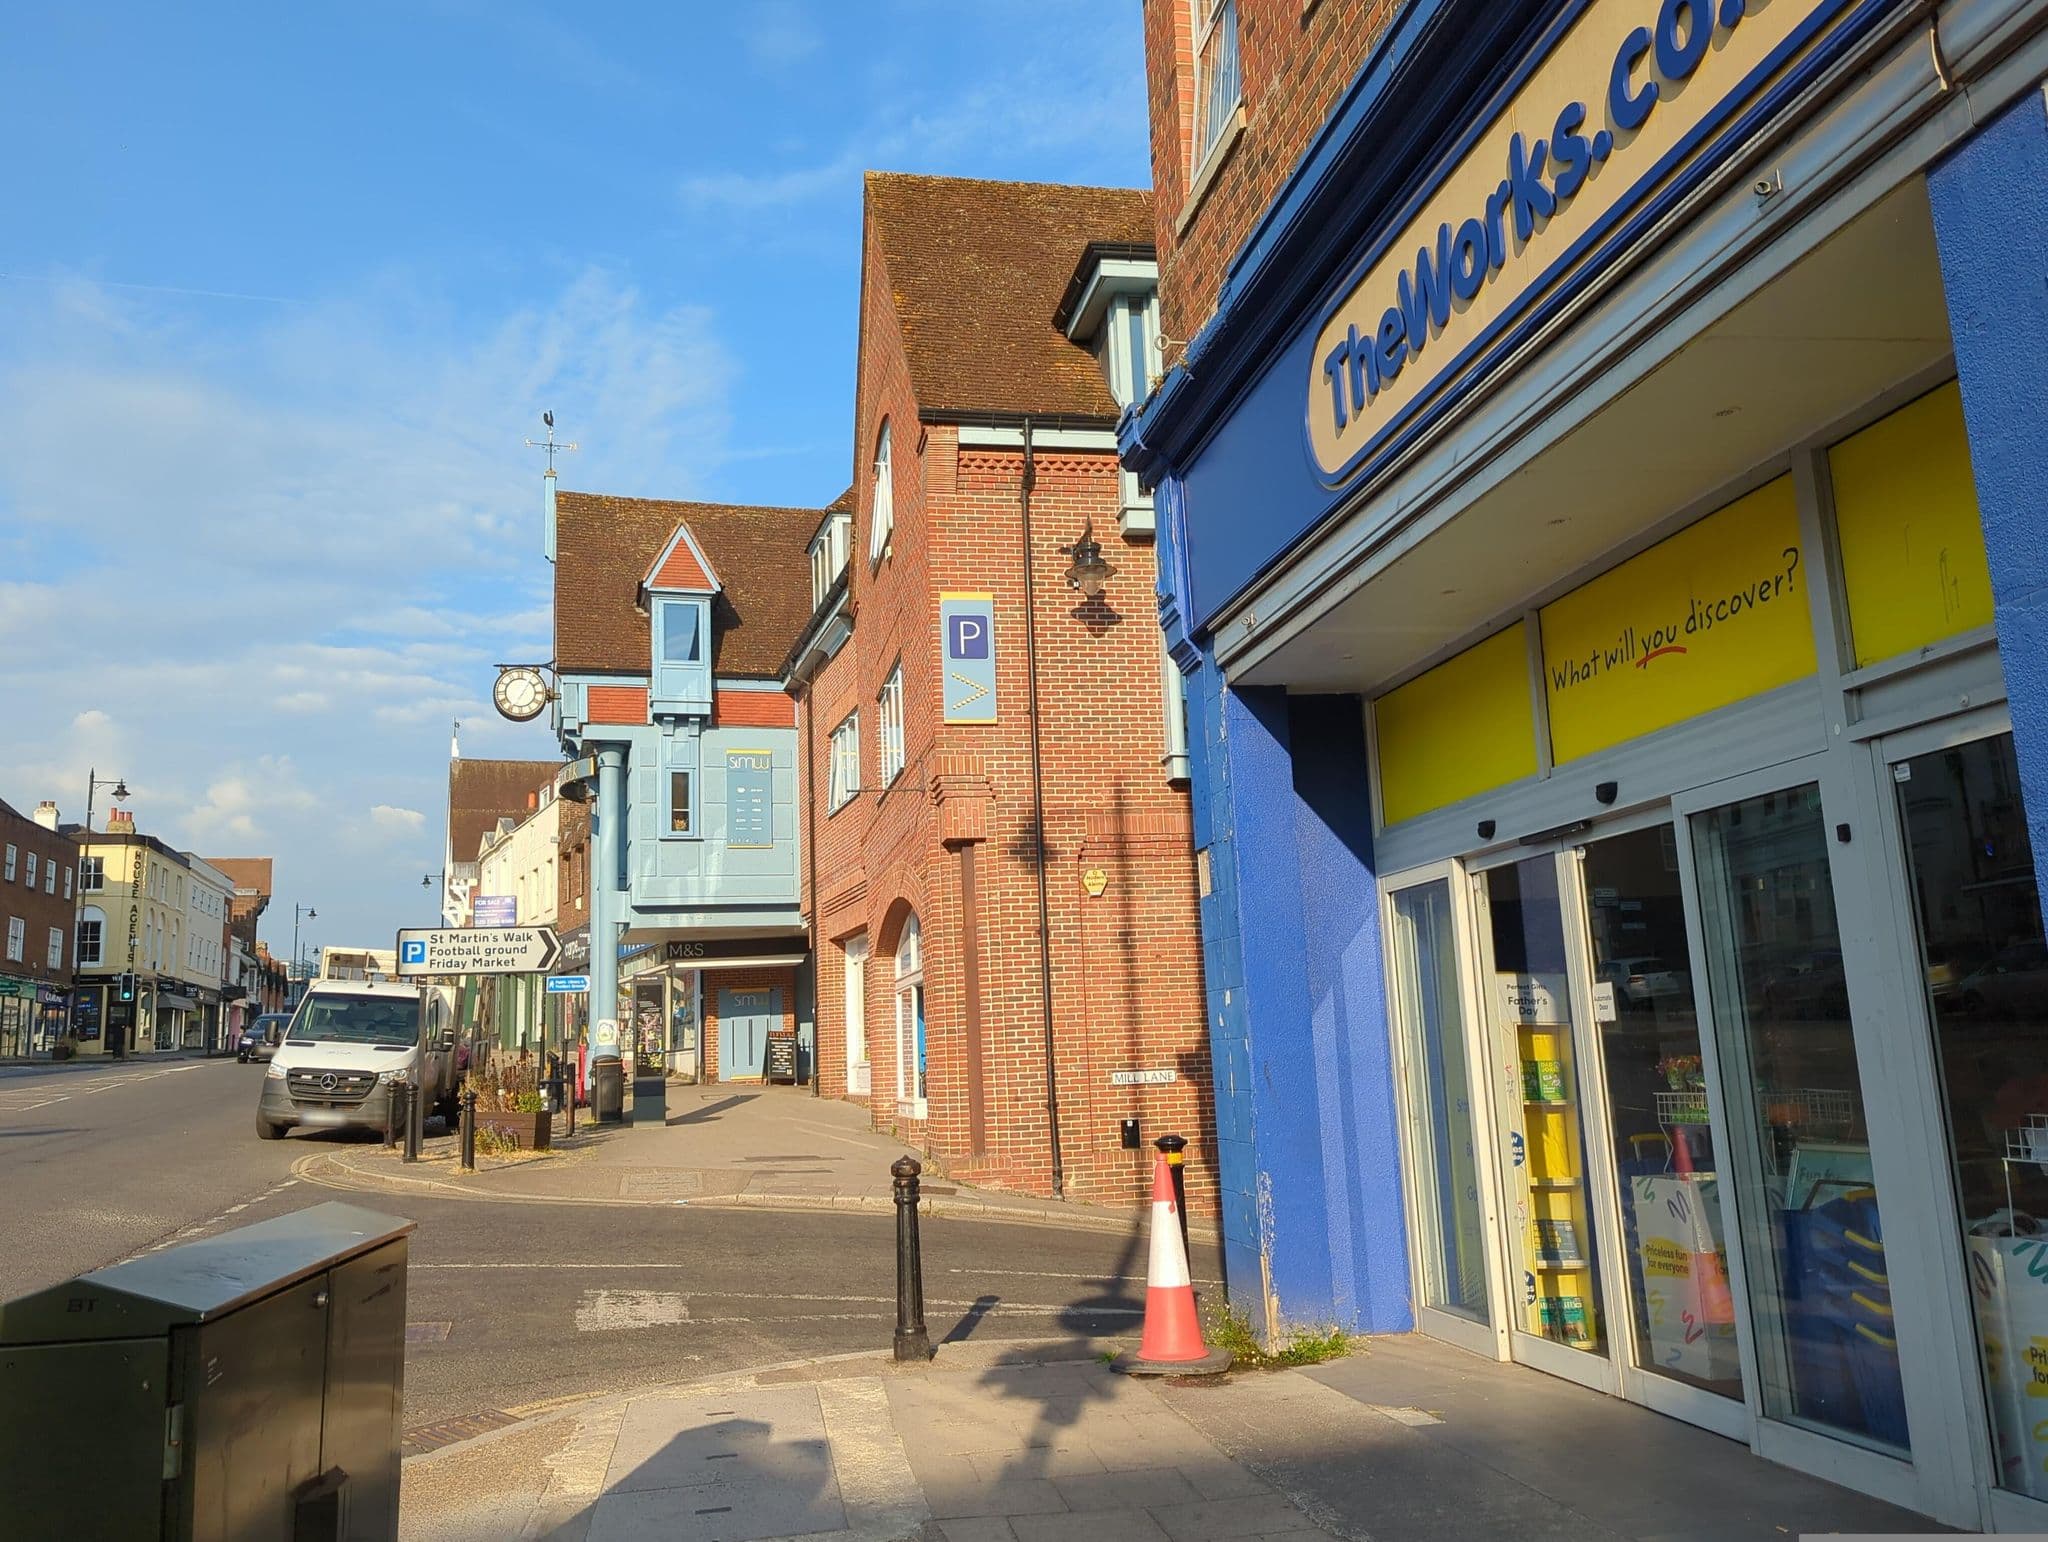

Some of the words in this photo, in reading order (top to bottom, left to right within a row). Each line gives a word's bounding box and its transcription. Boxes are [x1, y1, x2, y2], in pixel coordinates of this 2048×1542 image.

[1551, 649, 1600, 692] What
[1604, 627, 1636, 671] will
[1641, 624, 1677, 670] you
[1684, 547, 1799, 635] discover?
[959, 620, 980, 656] P
[132, 850, 142, 899] HOUSE
[430, 934, 444, 944] St
[450, 933, 499, 944] Martin's
[504, 932, 533, 943] Walk
[407, 944, 422, 962] P
[430, 946, 480, 957] Football
[484, 945, 527, 957] ground
[669, 943, 704, 957] M&S
[430, 958, 467, 970] Friday
[472, 957, 515, 968] Market
[1508, 996, 1548, 1006] Father's
[1519, 1006, 1538, 1016] Day
[1114, 1073, 1140, 1083] MILL
[1143, 1071, 1174, 1082] LANE
[1646, 1244, 1675, 1260] Priceless
[1675, 1250, 1688, 1262] fun
[1647, 1257, 1657, 1267] for
[1657, 1261, 1689, 1274] everyone
[66, 1297, 98, 1313] BT
